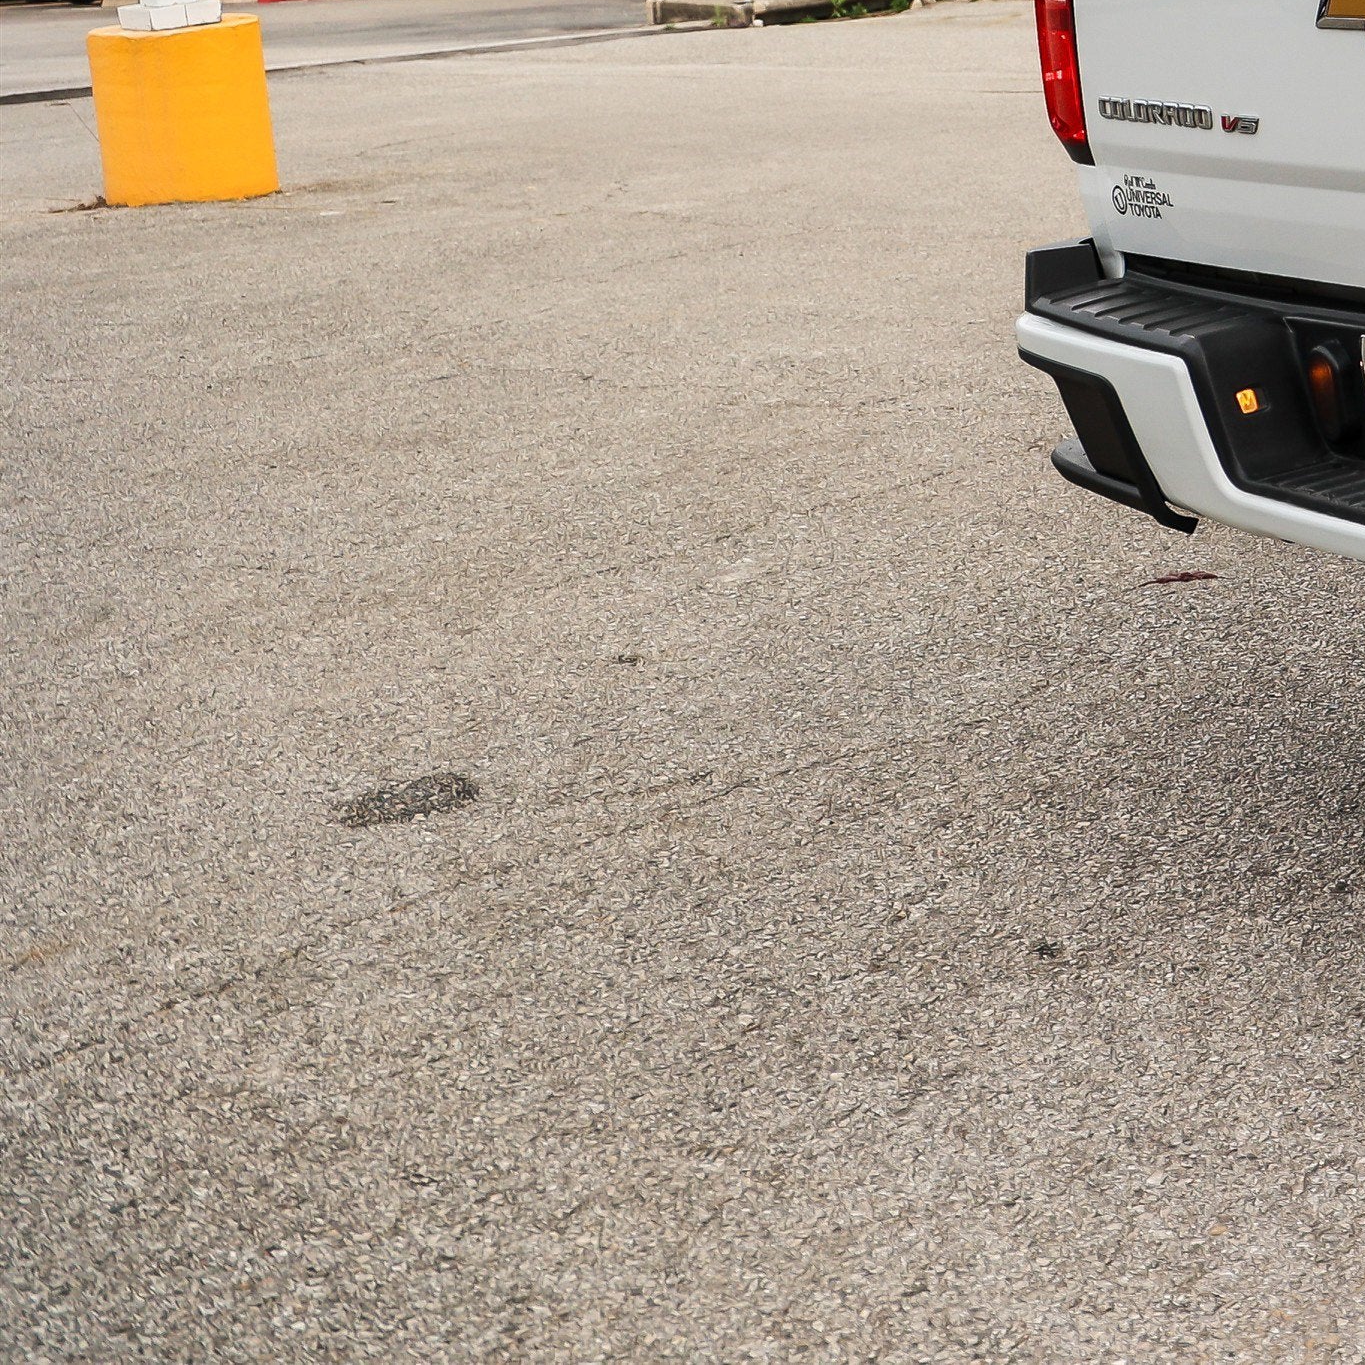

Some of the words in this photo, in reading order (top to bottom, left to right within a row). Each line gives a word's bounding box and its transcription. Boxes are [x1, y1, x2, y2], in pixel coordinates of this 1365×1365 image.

[1098, 96, 1213, 130] COLORADO
[1220, 114, 1259, 135] V6
[1126, 189, 1174, 207] UNIVERSAL
[1128, 203, 1162, 219] TOYOTA
